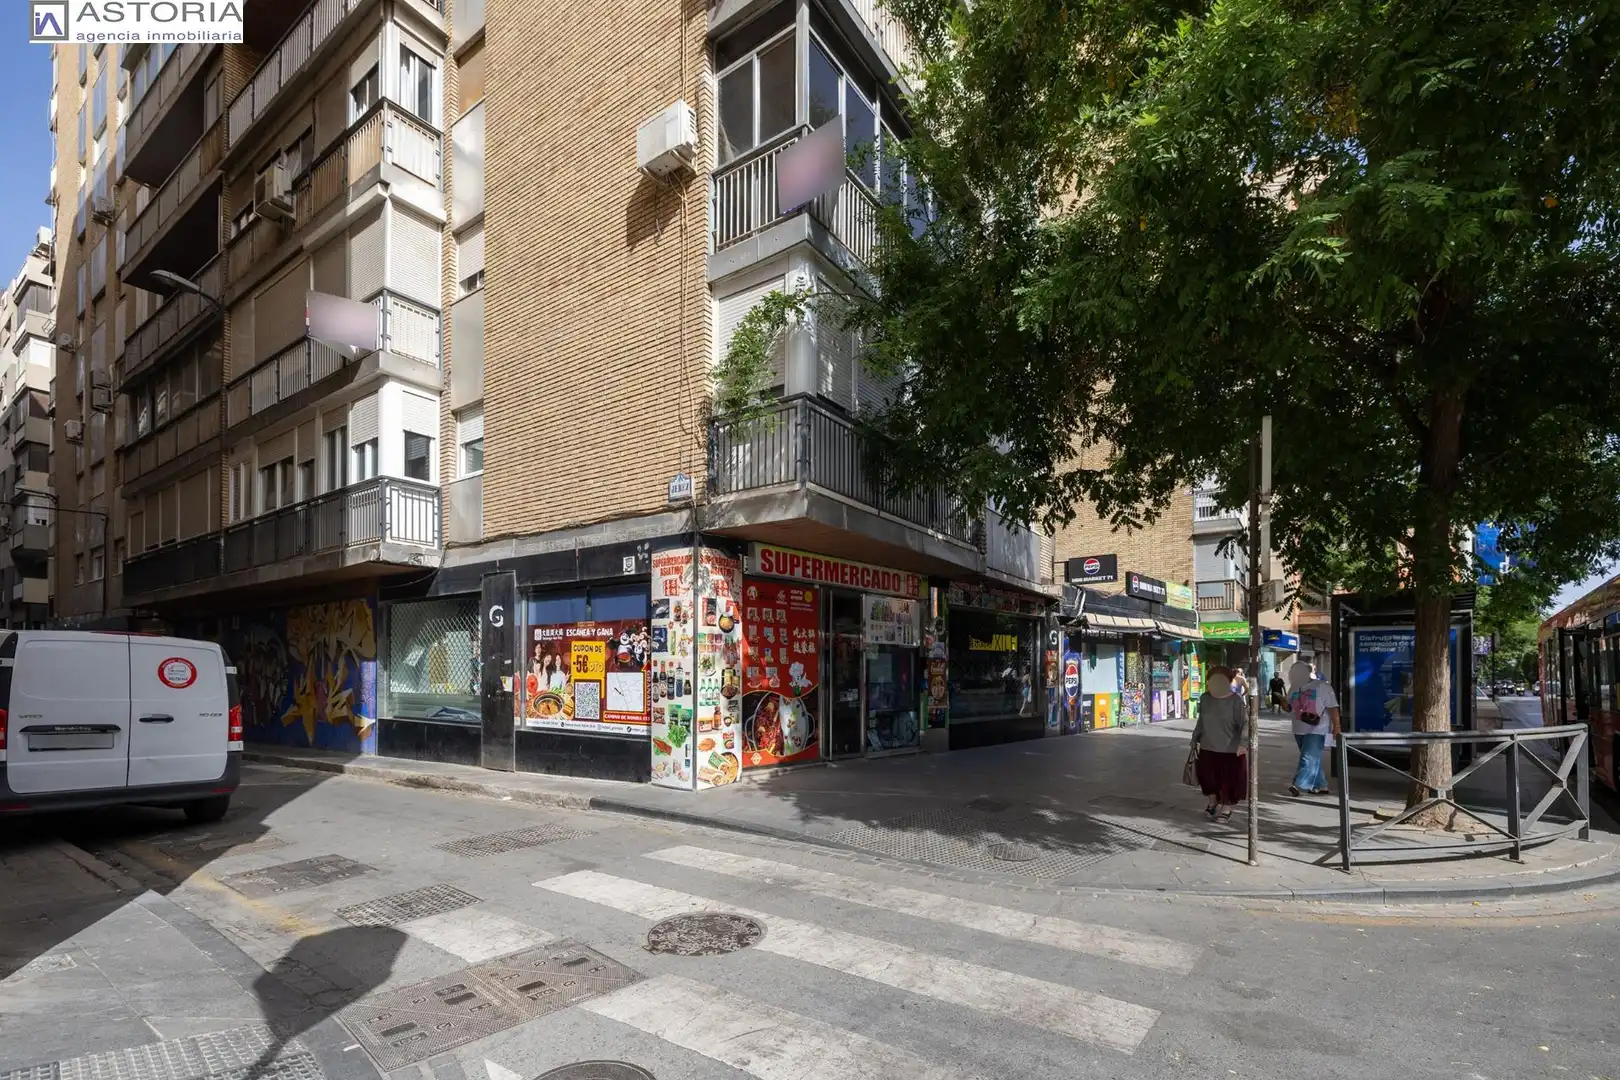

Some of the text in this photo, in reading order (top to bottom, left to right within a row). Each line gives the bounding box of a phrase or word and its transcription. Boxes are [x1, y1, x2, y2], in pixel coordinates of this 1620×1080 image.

[760, 548, 901, 592] SUPERMERCADO
[566, 629, 590, 637] ESCANEA
[596, 628, 613, 637] GANA
[595, 645, 602, 653] DE
